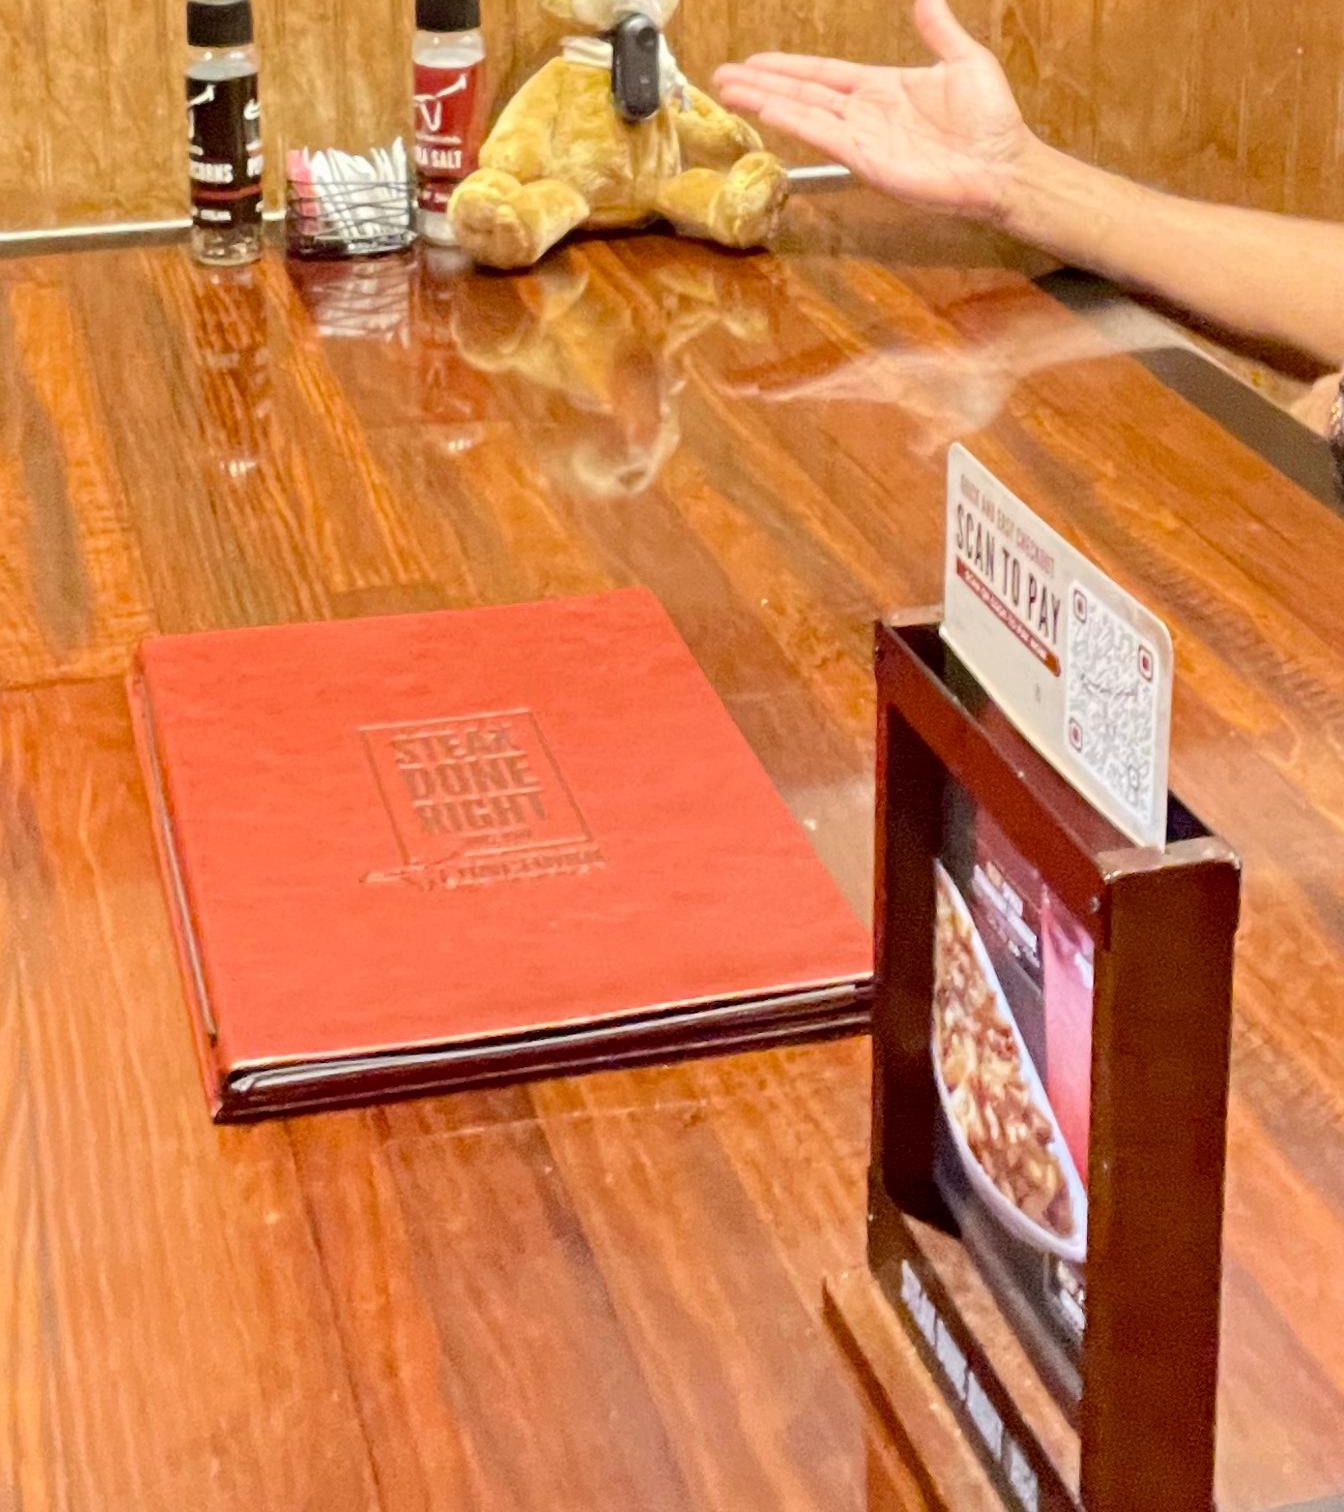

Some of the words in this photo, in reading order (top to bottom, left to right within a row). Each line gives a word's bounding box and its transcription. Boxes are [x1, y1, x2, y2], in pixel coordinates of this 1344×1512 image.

[431, 149, 462, 169] SALT
[956, 503, 995, 583] SCAN
[1001, 546, 1021, 607] TO
[1028, 572, 1061, 645] PAY
[400, 754, 540, 802] DONE
[415, 791, 546, 836] RIGHT
